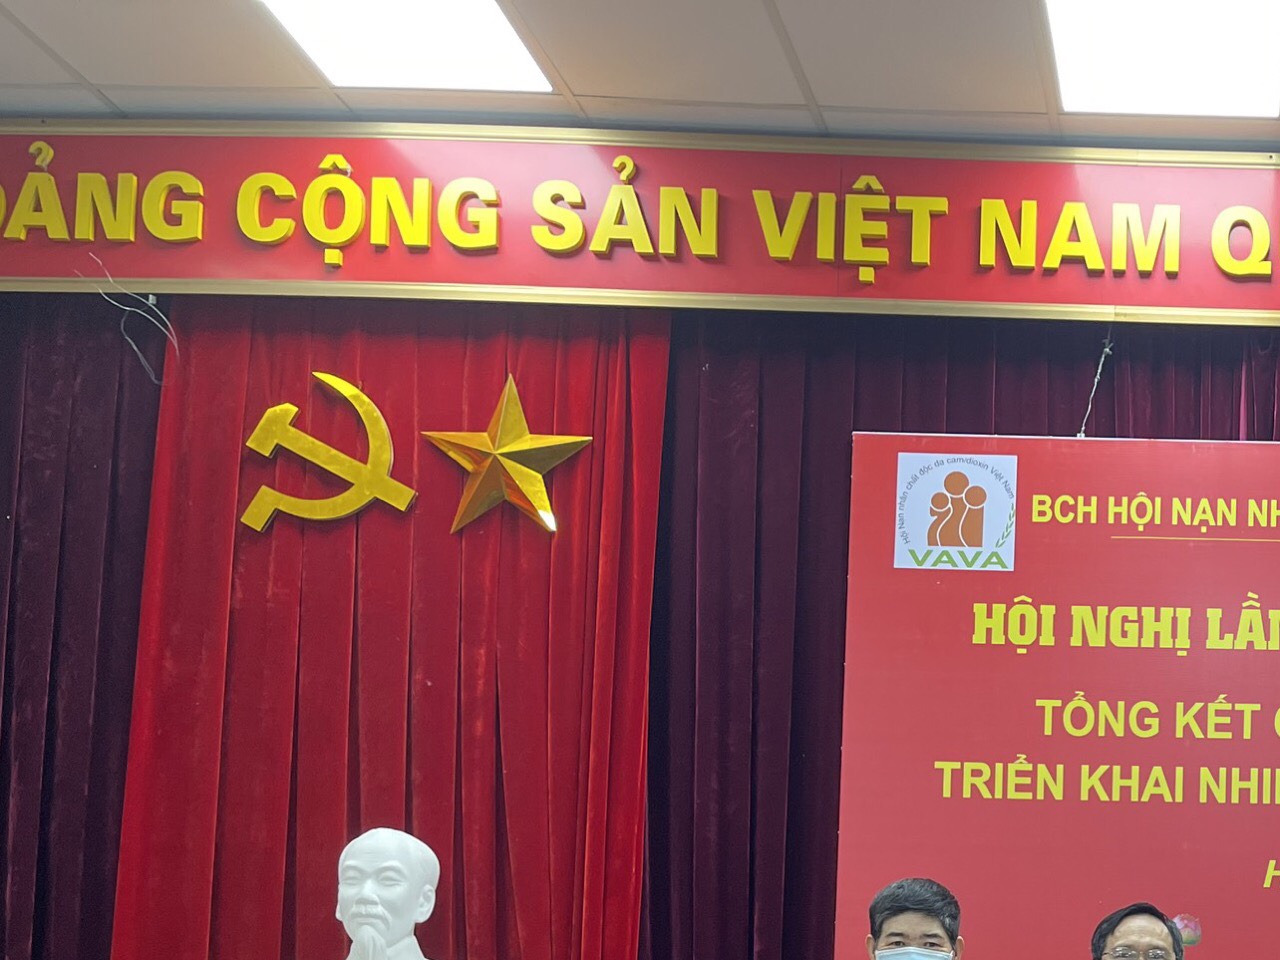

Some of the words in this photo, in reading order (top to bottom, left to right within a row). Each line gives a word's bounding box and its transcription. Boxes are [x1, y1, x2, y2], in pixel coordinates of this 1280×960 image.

[0, 140, 205, 242] ẢNG
[236, 153, 500, 267] CỘNG
[530, 154, 719, 257] SẢN
[752, 175, 949, 285] VIỆT
[979, 198, 1181, 274] NAM
[1031, 494, 1098, 524] BCH
[1107, 491, 1162, 532] HỘI
[1171, 497, 1237, 534] NẠN
[908, 549, 1008, 569] VAVA
[972, 595, 1056, 654] HỘI
[1069, 605, 1192, 657] NGHỊ
[1035, 691, 1160, 738] TỔNG
[1175, 694, 1261, 739] KẾT
[934, 754, 1064, 801] TRIỂN
[1080, 764, 1184, 803] KHAI
